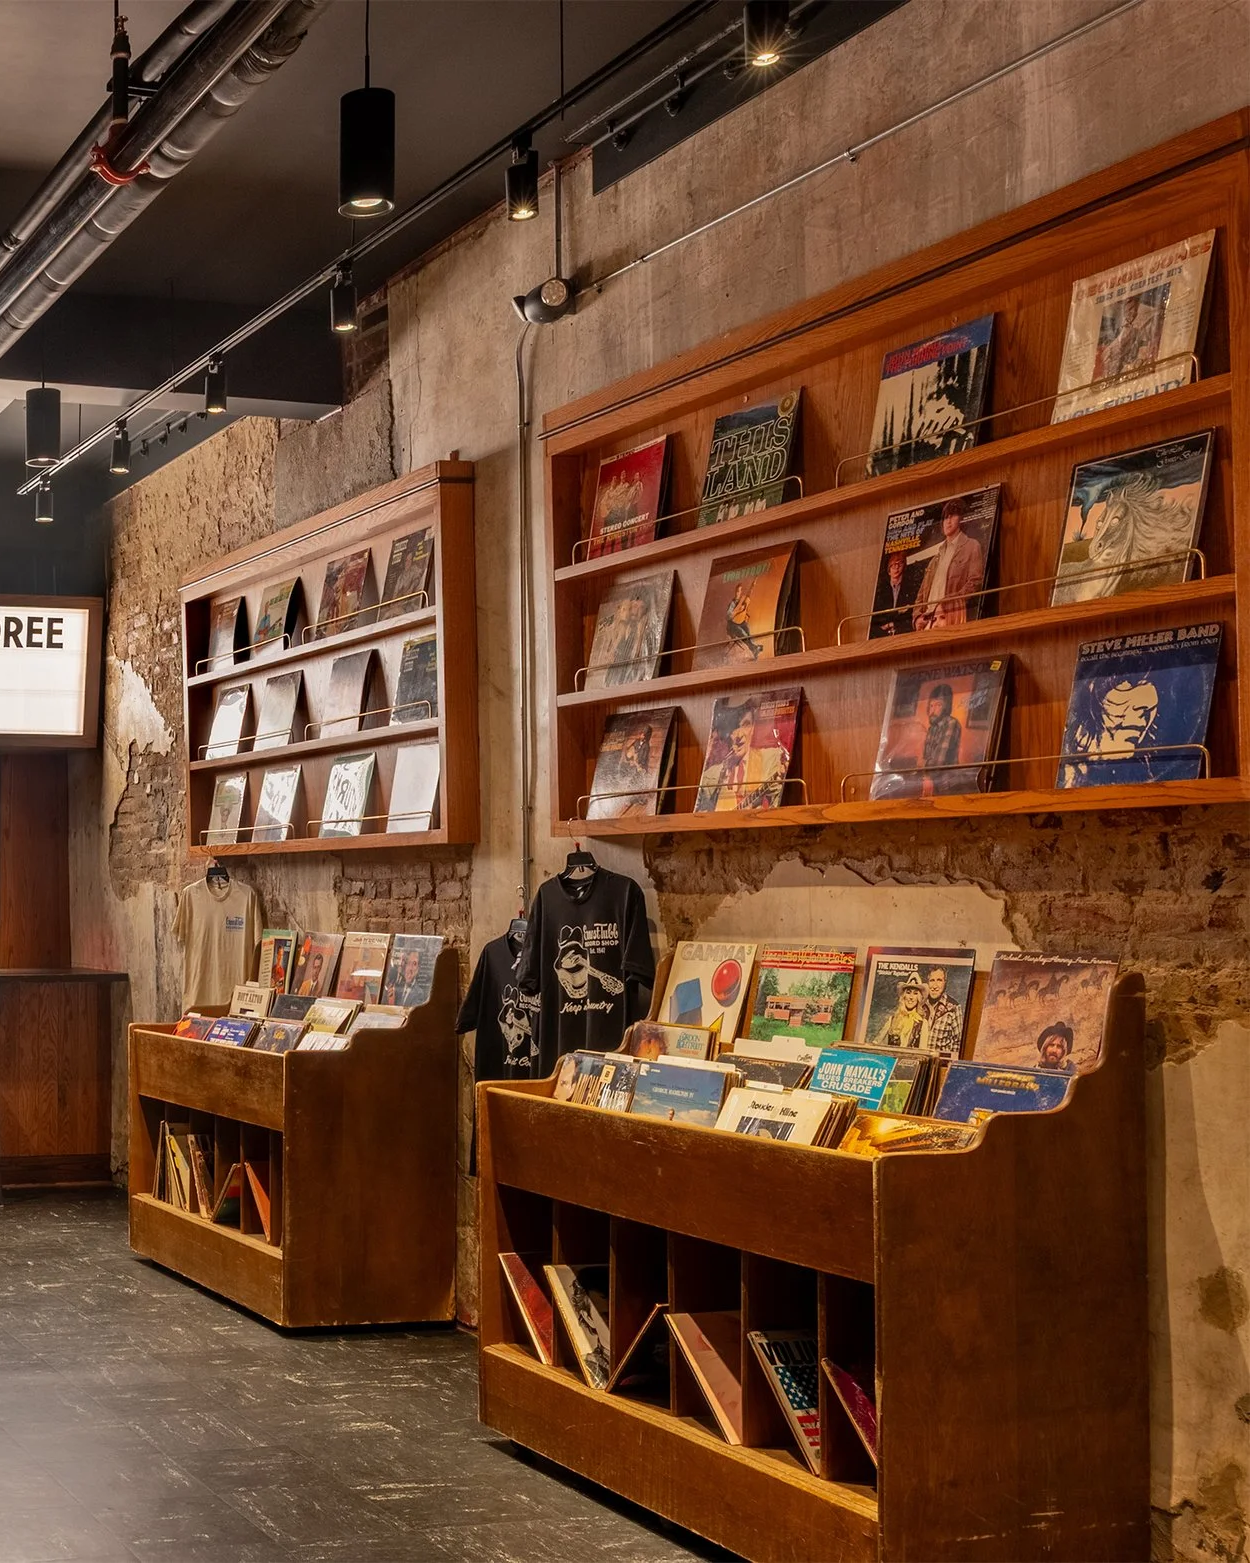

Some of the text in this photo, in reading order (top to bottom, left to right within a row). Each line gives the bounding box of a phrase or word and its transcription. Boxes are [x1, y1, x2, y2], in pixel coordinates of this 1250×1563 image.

[1150, 240, 1212, 273] JONES
[711, 413, 793, 469] THIS
[703, 447, 787, 501] LAND
[600, 512, 649, 535] STEREO CONCERT
[911, 509, 925, 518] AND
[1081, 624, 1220, 655] STEVE MILLER BAND
[878, 962, 919, 971] THE KENDALLS
[817, 1073, 883, 1087] BLUES BREAKERS
[818, 1062, 887, 1081] JOHN MAYALL'S
[821, 1080, 872, 1095] CRUSADE
